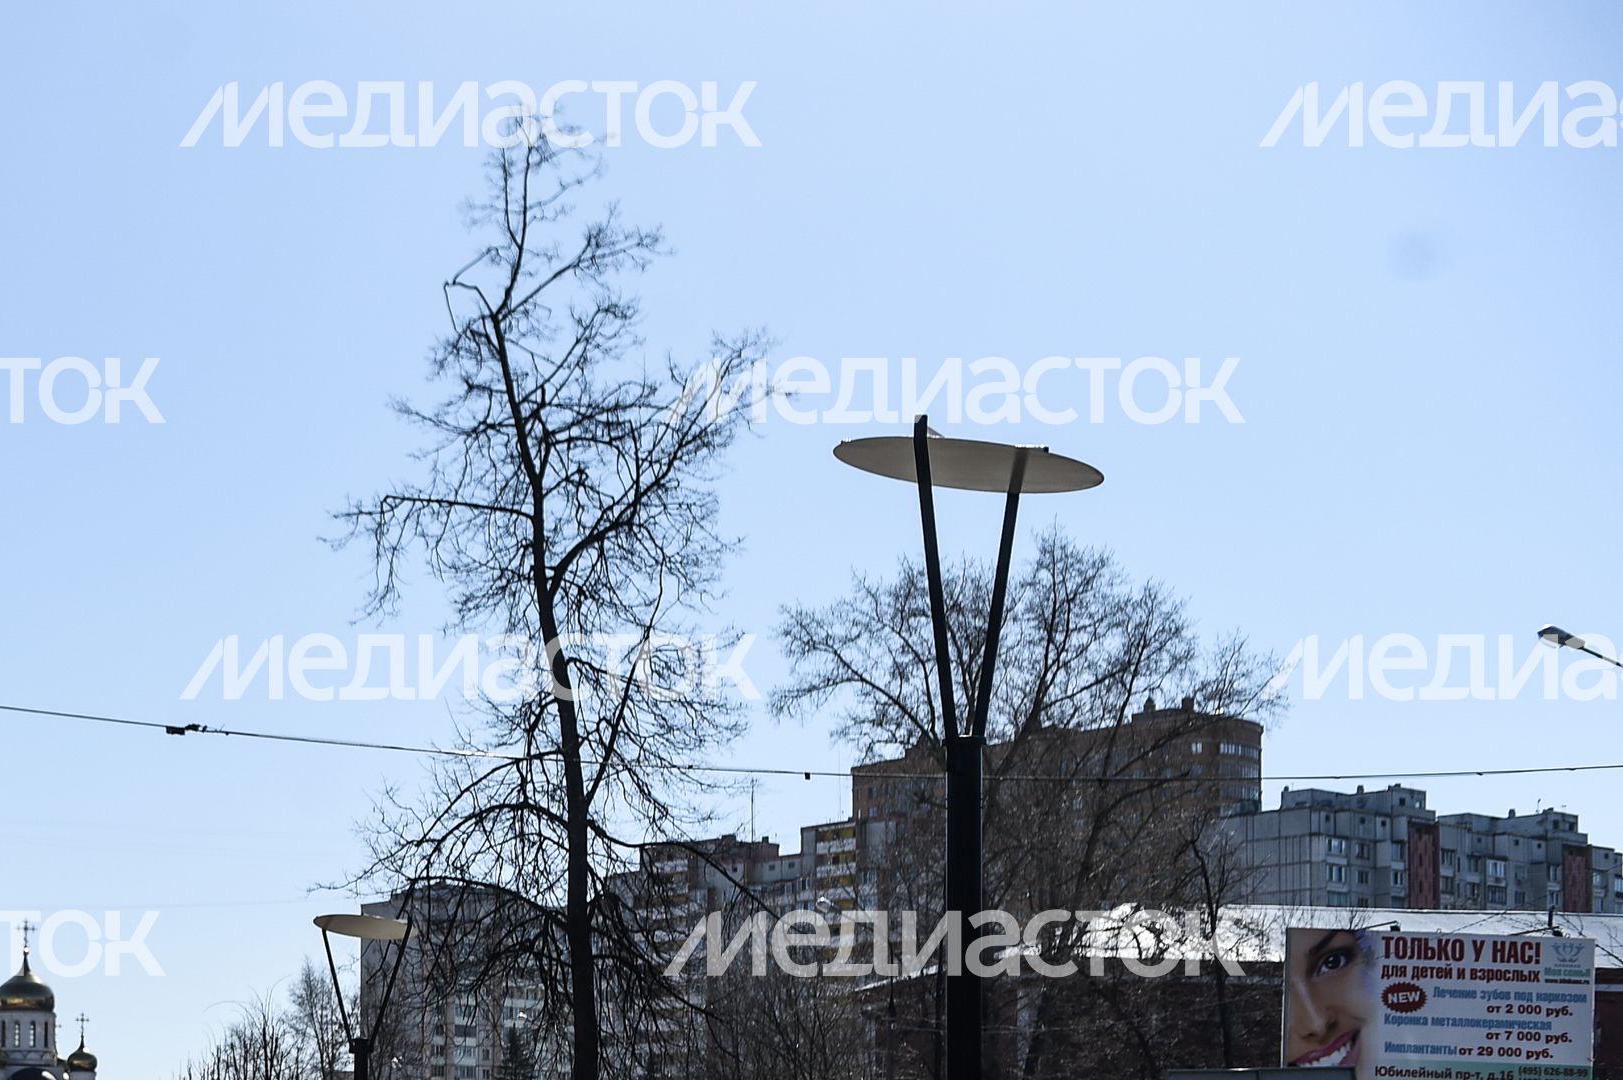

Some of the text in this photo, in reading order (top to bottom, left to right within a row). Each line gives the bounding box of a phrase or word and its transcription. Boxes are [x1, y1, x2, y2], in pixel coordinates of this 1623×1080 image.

[1381, 936, 1541, 965] ТОЛЬКО У НАС!
[1381, 963, 1541, 984] для детей и взрослых
[1387, 991, 1421, 1004] NEW
[1433, 986, 1588, 1004] Лечение зубов под наркозом
[1486, 1004, 1574, 1018] от 2 000 руб.
[1384, 1013, 1553, 1031] Коронка металлокерамическая
[1486, 1031, 1573, 1045] от 7 000 руб.
[1384, 1041, 1554, 1060] Имплантанты от 29 000 руб.
[1374, 1065, 1452, 1080] Юбилейный
[1518, 1066, 1588, 1078] (495) 626-88-99
